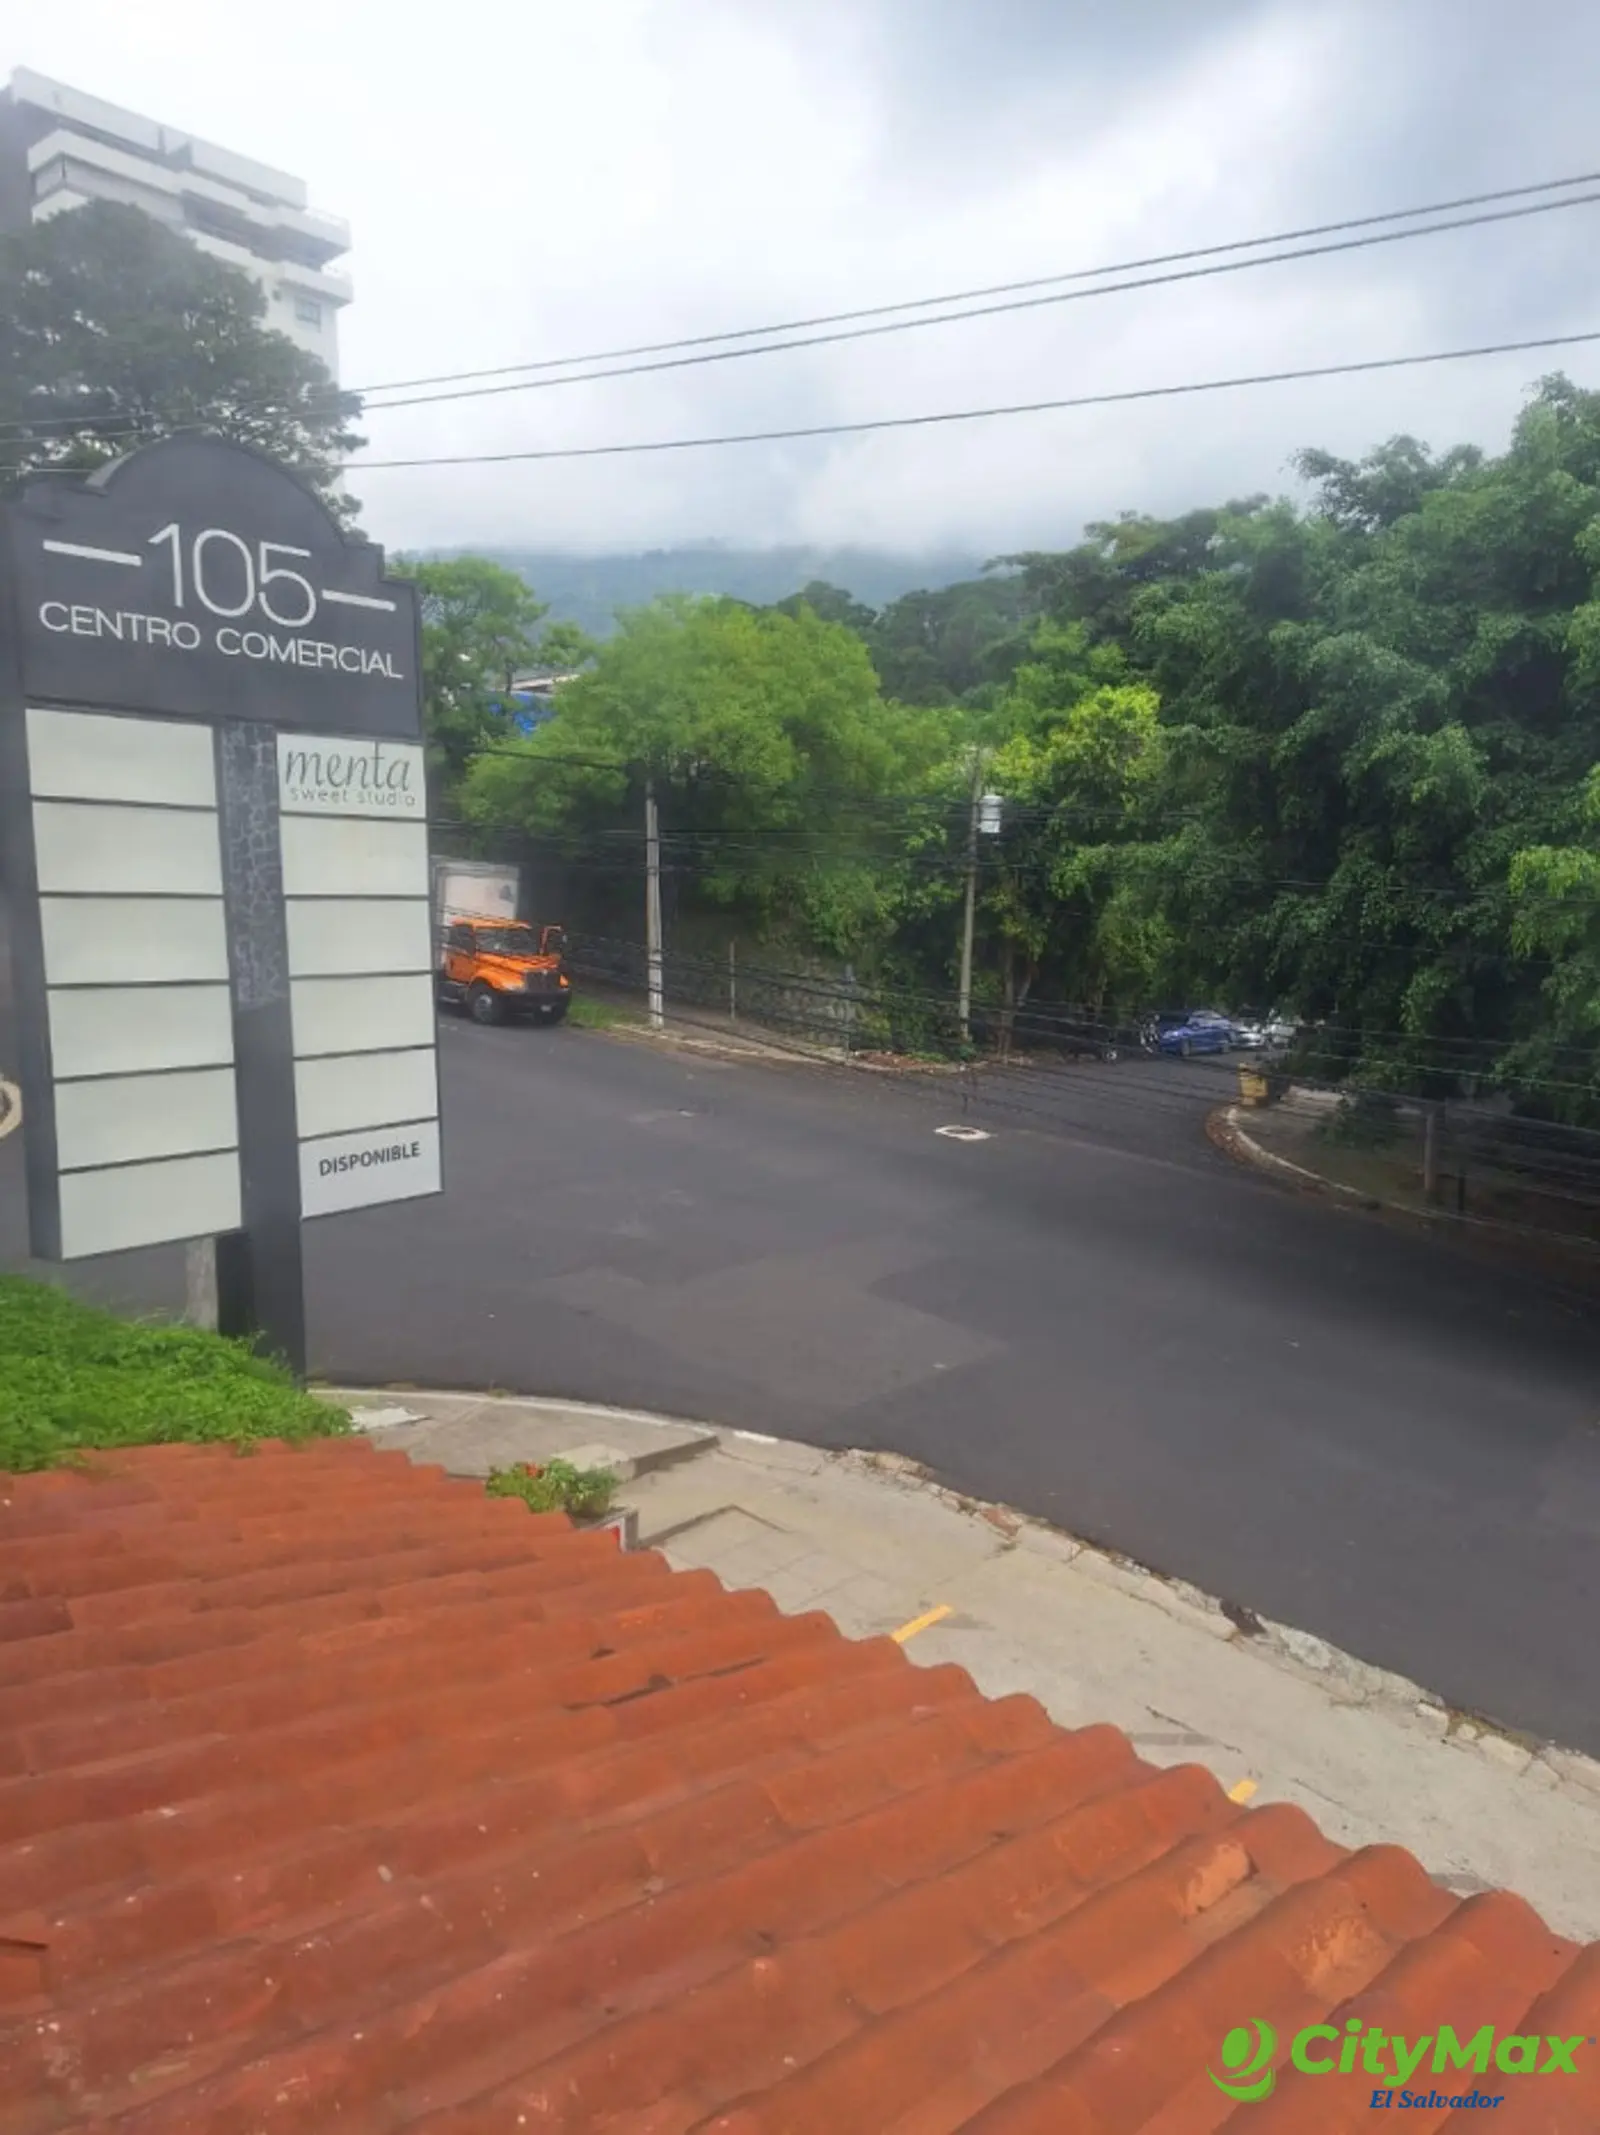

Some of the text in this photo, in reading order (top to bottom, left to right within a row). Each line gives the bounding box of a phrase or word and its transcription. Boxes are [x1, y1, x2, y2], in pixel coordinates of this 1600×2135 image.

[148, 523, 317, 628] 105
[39, 601, 405, 680] CENTRO COMERCIAL
[285, 740, 411, 792] menta
[289, 786, 416, 808] sweet studio
[319, 1141, 421, 1177] DISPONIBLE
